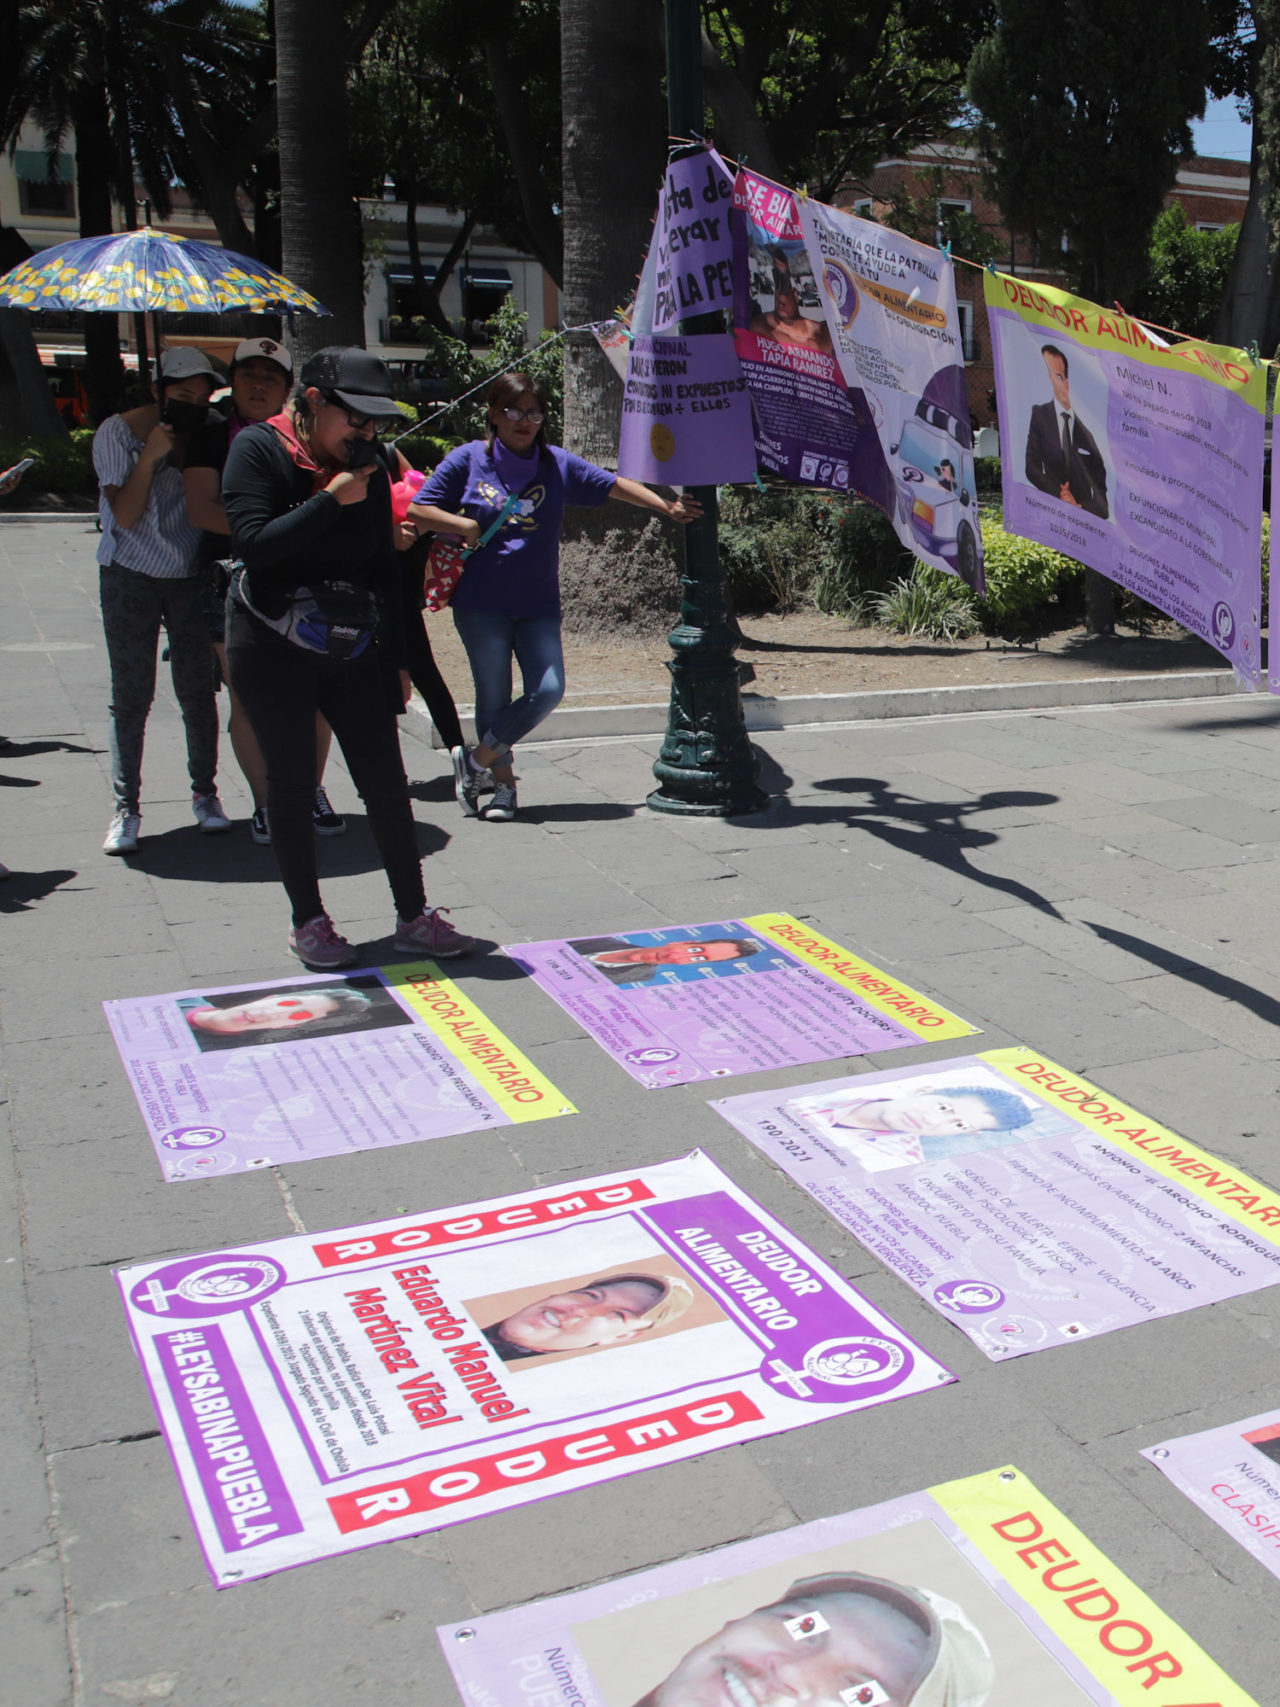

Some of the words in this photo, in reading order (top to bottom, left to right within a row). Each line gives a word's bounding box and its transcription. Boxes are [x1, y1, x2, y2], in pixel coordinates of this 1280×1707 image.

[1004, 279, 1088, 334] DEUDOR
[677, 377, 747, 399] EXPUESTOS
[756, 336, 787, 354] HUGO
[788, 345, 835, 370] ARMANDO
[761, 349, 790, 368] TAPIA
[793, 358, 835, 381] RAMIREZ
[691, 398, 731, 413] ELLOS
[766, 923, 843, 960] DEUDOR
[828, 961, 948, 1028] ALIMENTARIO
[402, 972, 468, 1019] DEUDOR
[449, 1021, 541, 1102] ALIMENTARIO
[1016, 1063, 1123, 1123] DEUDOR
[759, 1120, 811, 1161] 190/2021
[1088, 1142, 1140, 1175] ANTONIO
[332, 1183, 638, 1262] DEUDOR
[1003, 1158, 1047, 1185] TIEMPO
[1041, 1183, 1057, 1192] DE
[1144, 1256, 1162, 1266] 14
[1160, 1267, 1192, 1289] AÑOS
[1053, 1151, 1103, 1182] INFANCIAS
[1182, 1237, 1241, 1276] INFANCIAS
[673, 1224, 801, 1332] ALIMENTARIO
[734, 1229, 826, 1297] DEUDOR
[344, 1284, 431, 1373] Martínez
[391, 1370, 463, 1431] Vital
[393, 1263, 474, 1343] Eduardo
[443, 1339, 530, 1423] Manuel
[167, 1329, 281, 1543] #LEYSABINAPUEBLA
[352, 1397, 742, 1523] DEUDOR
[991, 1509, 1184, 1691] DEUDOR
